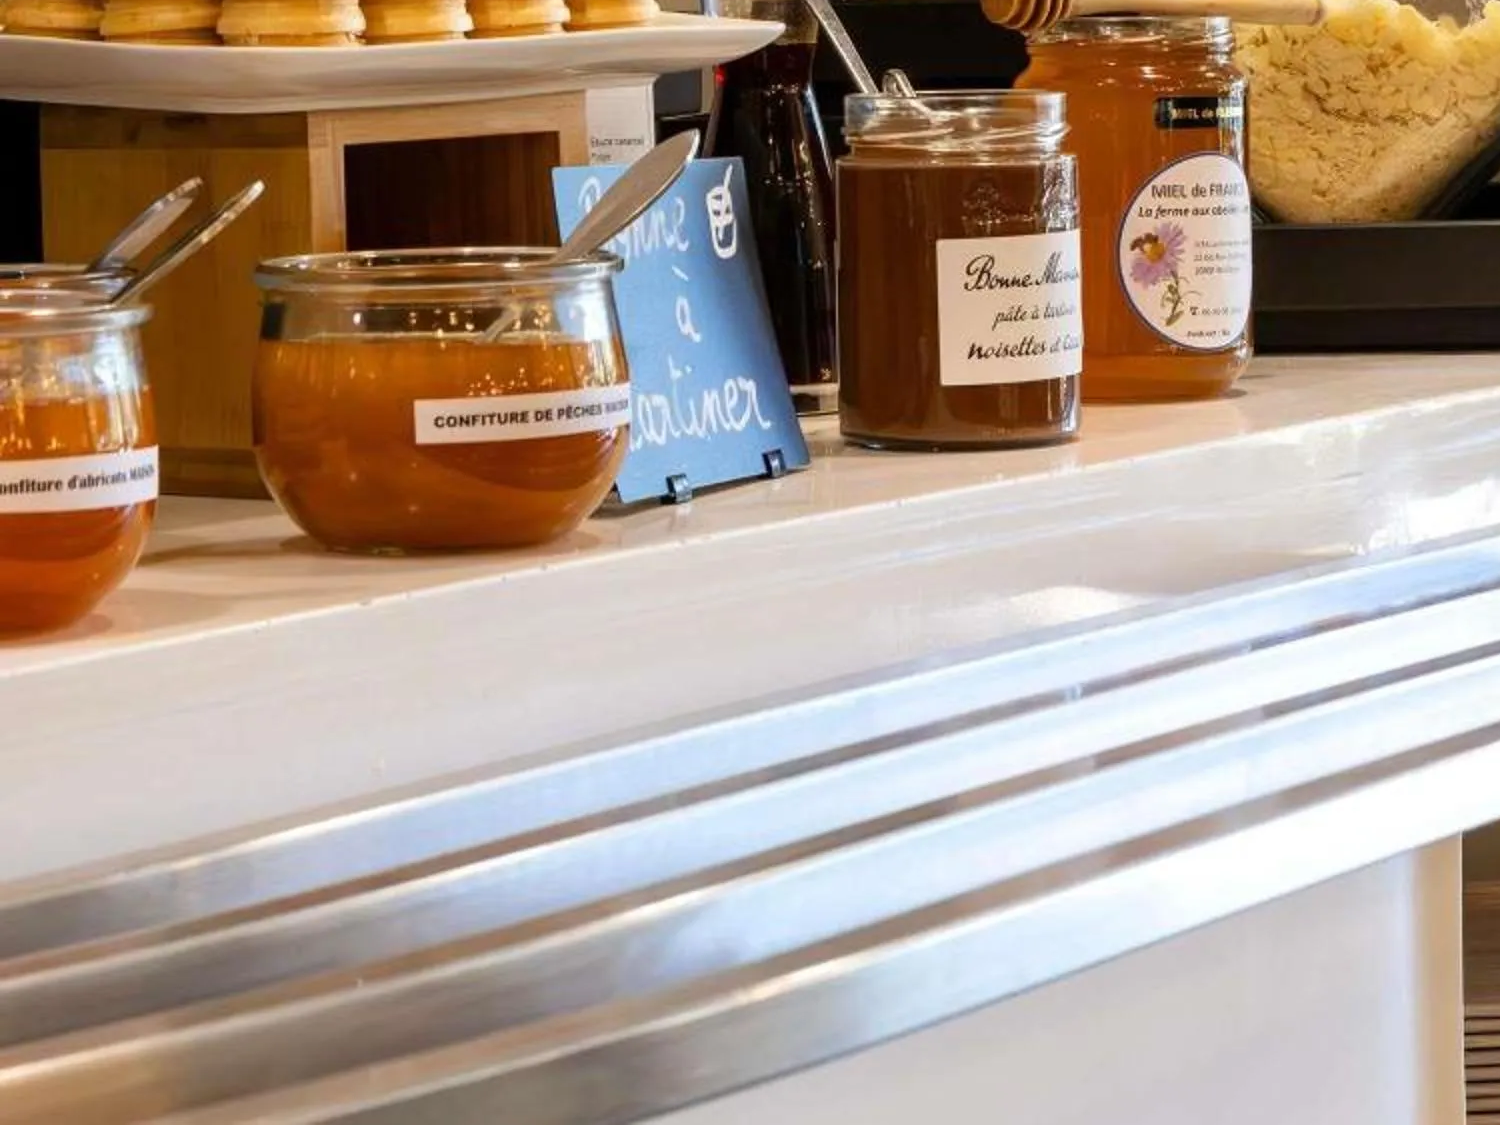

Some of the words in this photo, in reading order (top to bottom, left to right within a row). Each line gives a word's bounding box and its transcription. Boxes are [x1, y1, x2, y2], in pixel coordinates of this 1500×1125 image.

[1151, 184, 1187, 198] MIEL
[1191, 183, 1206, 197] de
[1154, 206, 1190, 219] ferme
[964, 254, 1033, 291] Bonne
[992, 304, 1028, 331] pâte
[1031, 305, 1040, 321] à
[967, 335, 1046, 360] noisettes
[434, 409, 530, 428] CONFITURE
[535, 409, 552, 422] DE
[0, 477, 62, 496] onfiture
